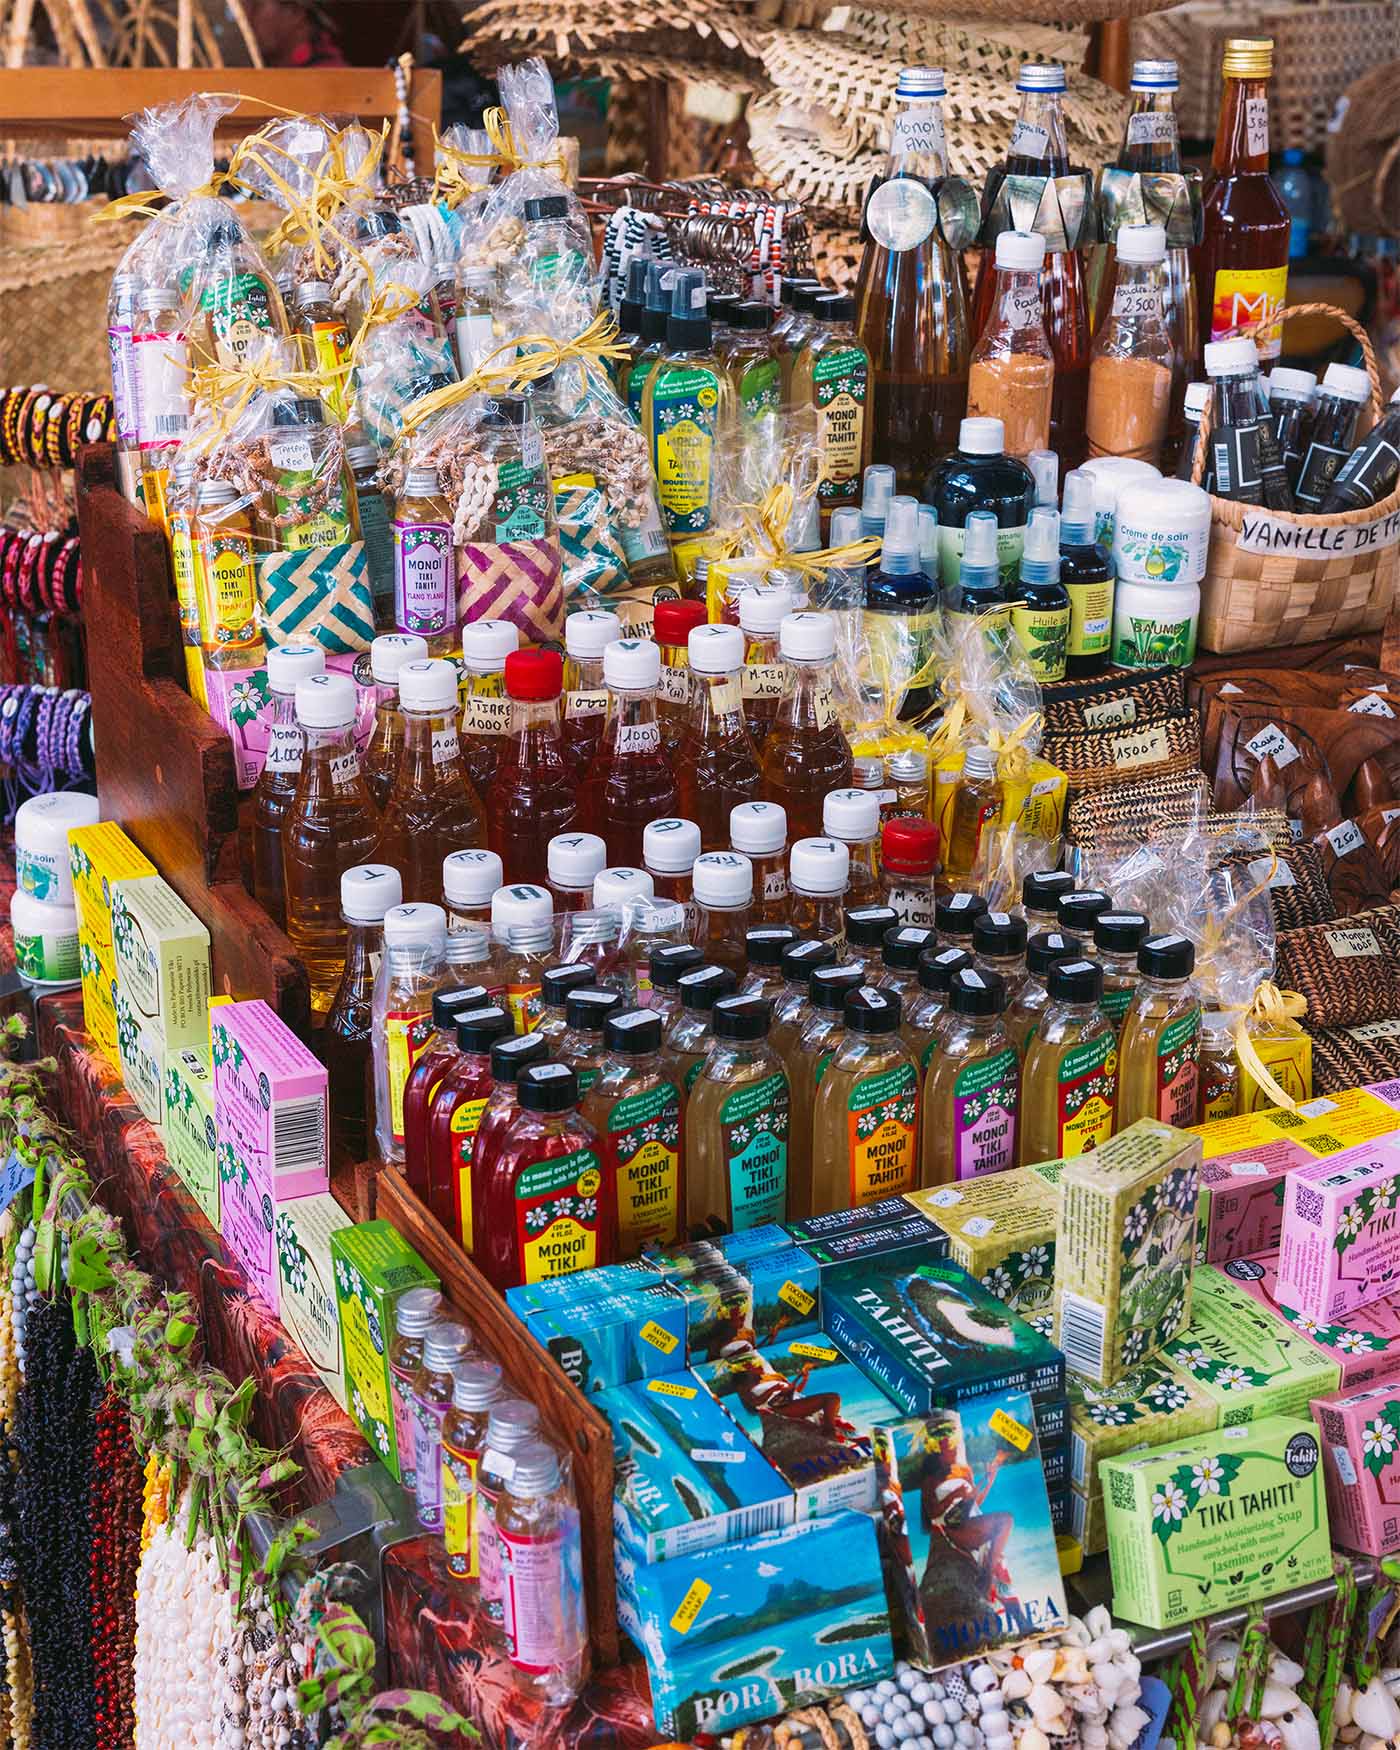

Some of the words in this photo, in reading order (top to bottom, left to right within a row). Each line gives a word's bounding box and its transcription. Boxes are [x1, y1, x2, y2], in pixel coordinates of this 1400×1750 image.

[832, 421, 851, 432] TIKI
[1151, 531, 1163, 542] de
[1167, 531, 1188, 542] soin
[1354, 526, 1376, 549] DE
[408, 557, 443, 572] MONOÏ
[415, 581, 437, 591] TAHITI
[418, 572, 434, 581] TIKI
[1134, 622, 1181, 635] BAUME
[972, 1120, 1008, 1145] MONOÏ
[867, 1135, 907, 1159] MONOÏ
[979, 1139, 1001, 1157] TIKI
[628, 1155, 670, 1181] MONOÏ
[742, 1145, 781, 1171] MONOÏ
[875, 1154, 898, 1170] TIKI
[973, 1151, 1006, 1172] TAHITI
[637, 1176, 662, 1193] TIKI
[749, 1167, 773, 1183] TIKI
[868, 1166, 904, 1186] TAHITI
[630, 1187, 669, 1208] TAHITI
[744, 1178, 779, 1199] TAHITI
[1368, 1212, 1396, 1238] TIKI
[539, 1235, 586, 1258] MONOÏ
[548, 1256, 577, 1271] TIKI
[852, 1288, 952, 1372] TAHITI
[1200, 1333, 1237, 1360] TIKI
[1034, 1365, 1060, 1378] TIKI
[1040, 1411, 1064, 1423] TIKI
[1286, 1449, 1317, 1463] Tahiti
[1196, 1500, 1235, 1529] TIKI
[1240, 1482, 1294, 1516] TAHITI
[1177, 1536, 1222, 1554] Handmade
[1276, 1509, 1302, 1526] Soap
[1212, 1553, 1256, 1576] Jasmine
[1165, 1606, 1188, 1619] VEGAN
[693, 1682, 782, 1725] BORA
[792, 1647, 879, 1694] BORA
